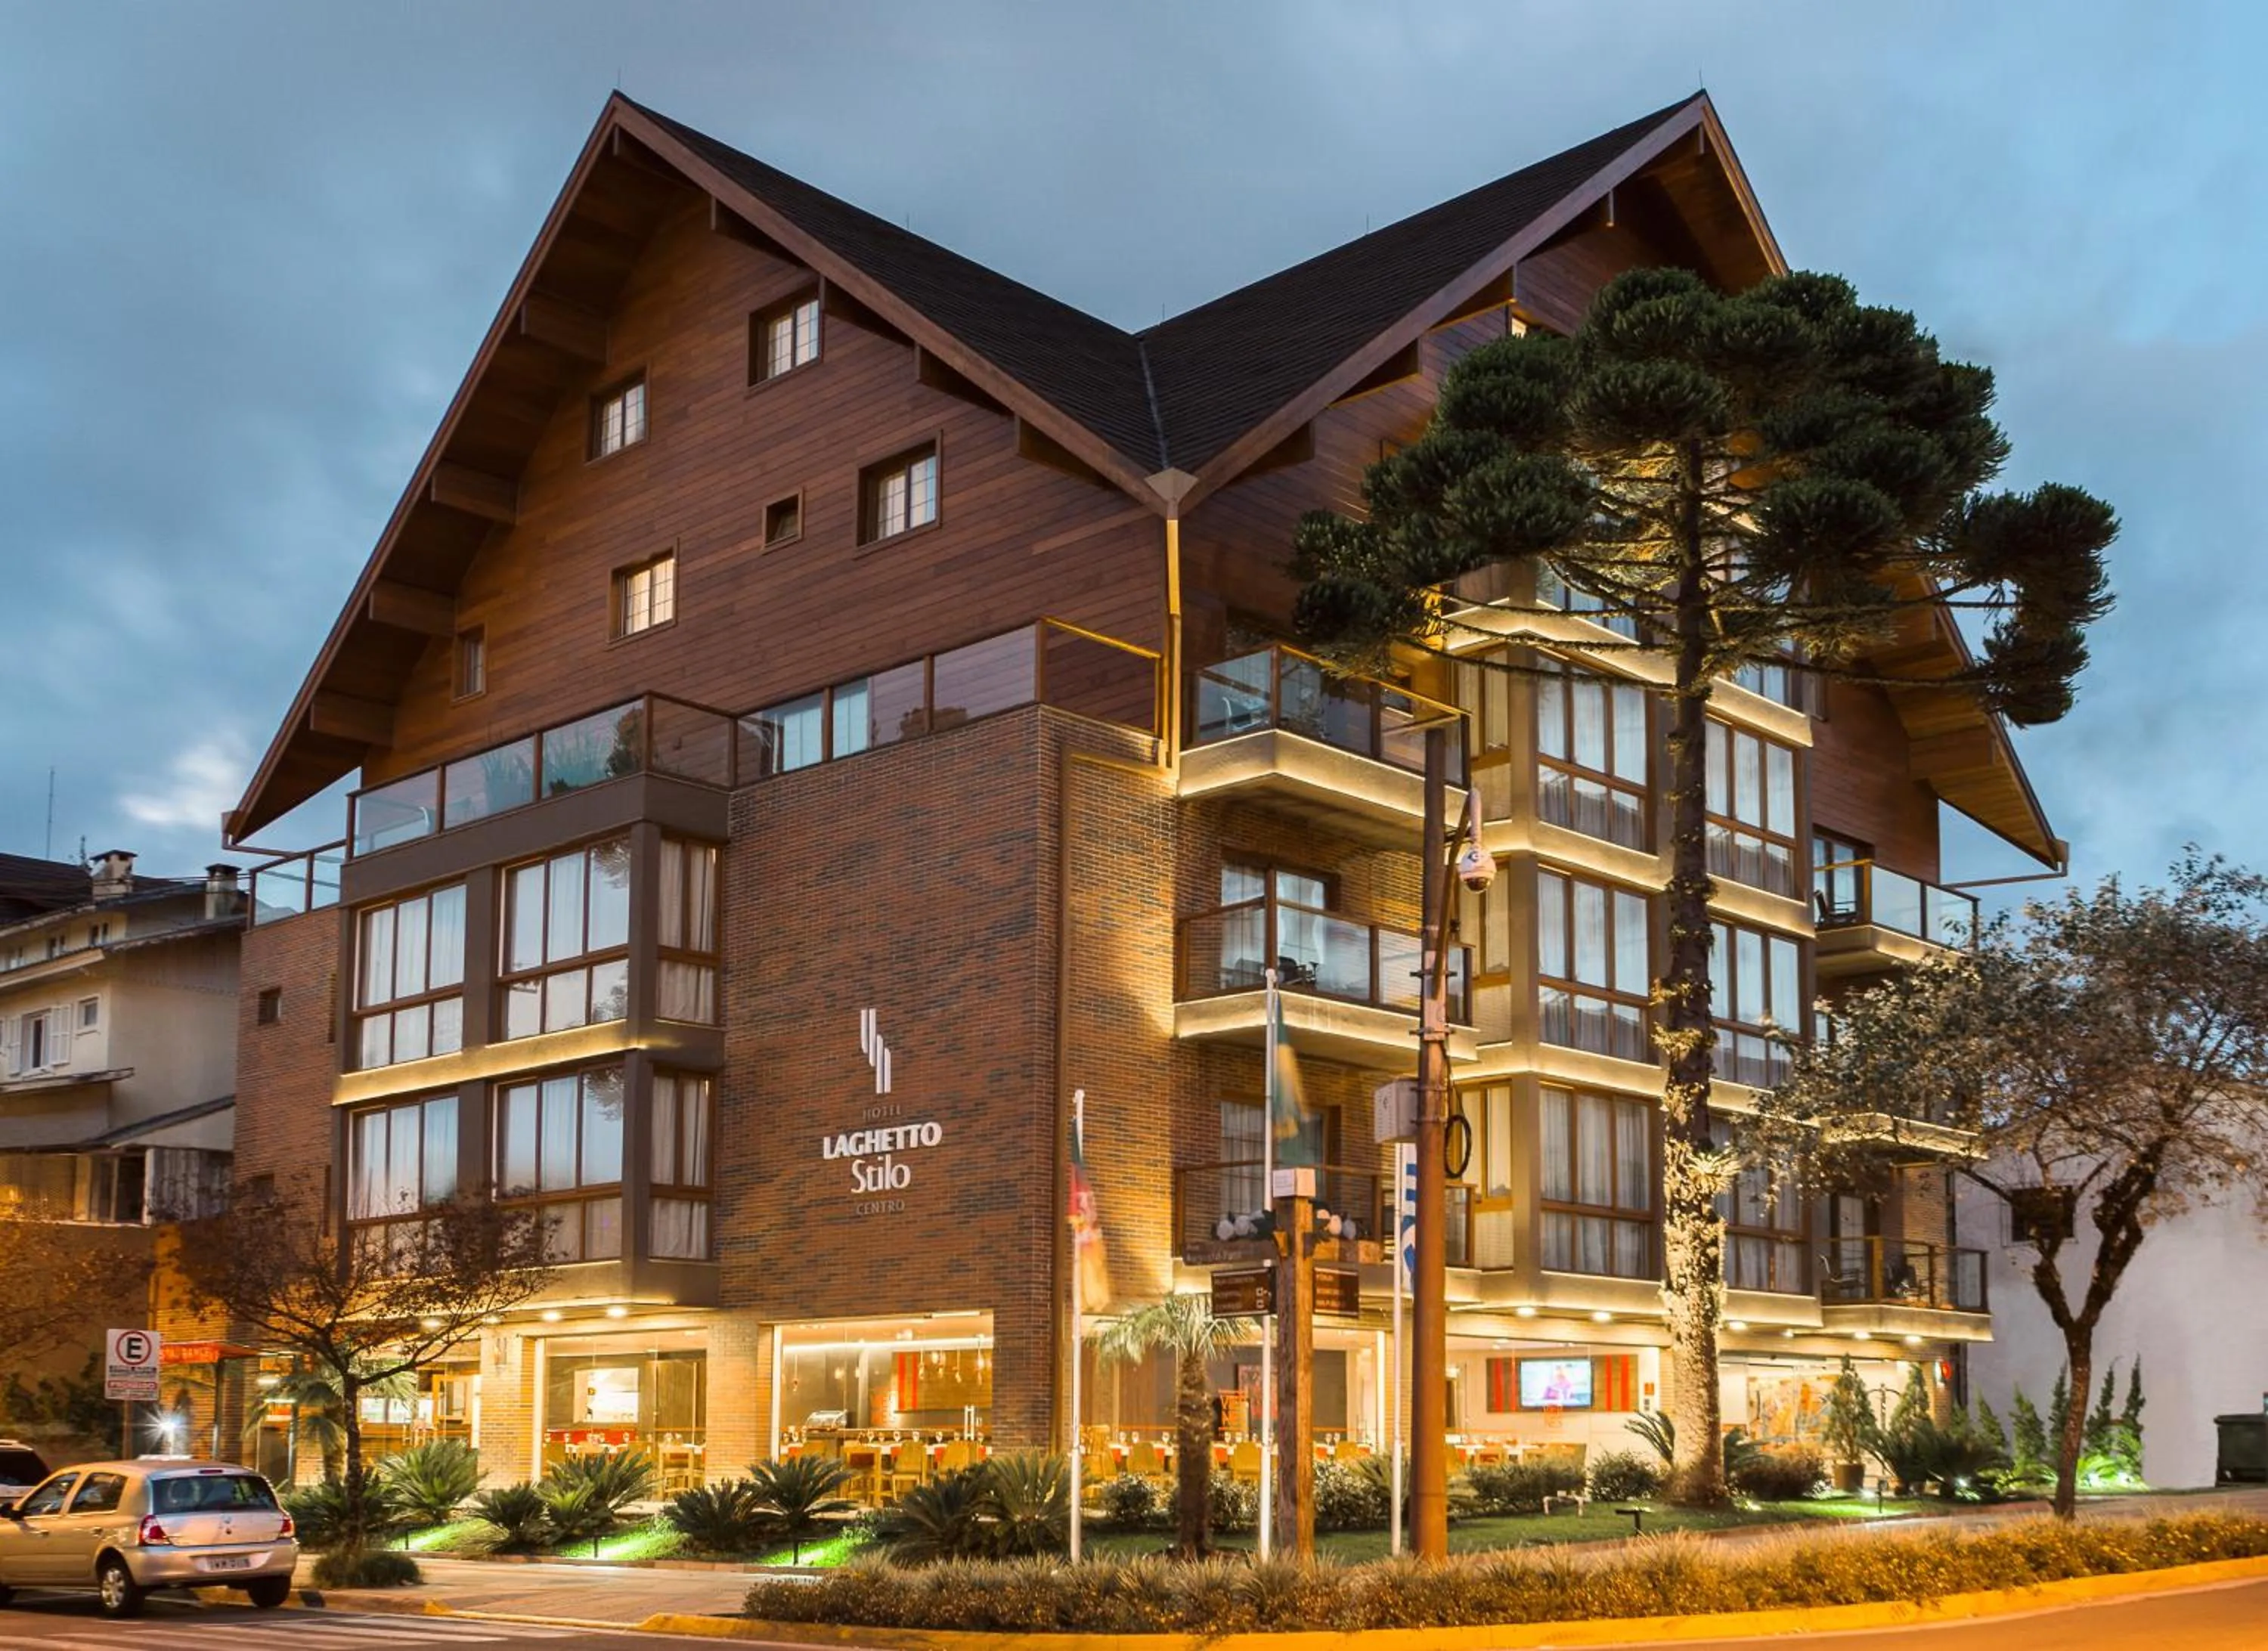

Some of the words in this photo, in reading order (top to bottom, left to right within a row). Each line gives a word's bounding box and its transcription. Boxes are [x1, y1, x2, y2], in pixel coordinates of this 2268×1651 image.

[863, 1104, 901, 1121] HOTEL
[823, 1122, 943, 1160] LAGHETTO
[850, 1154, 911, 1194] Stilo
[856, 1200, 906, 1216] CENTRO
[127, 1337, 142, 1359] E
